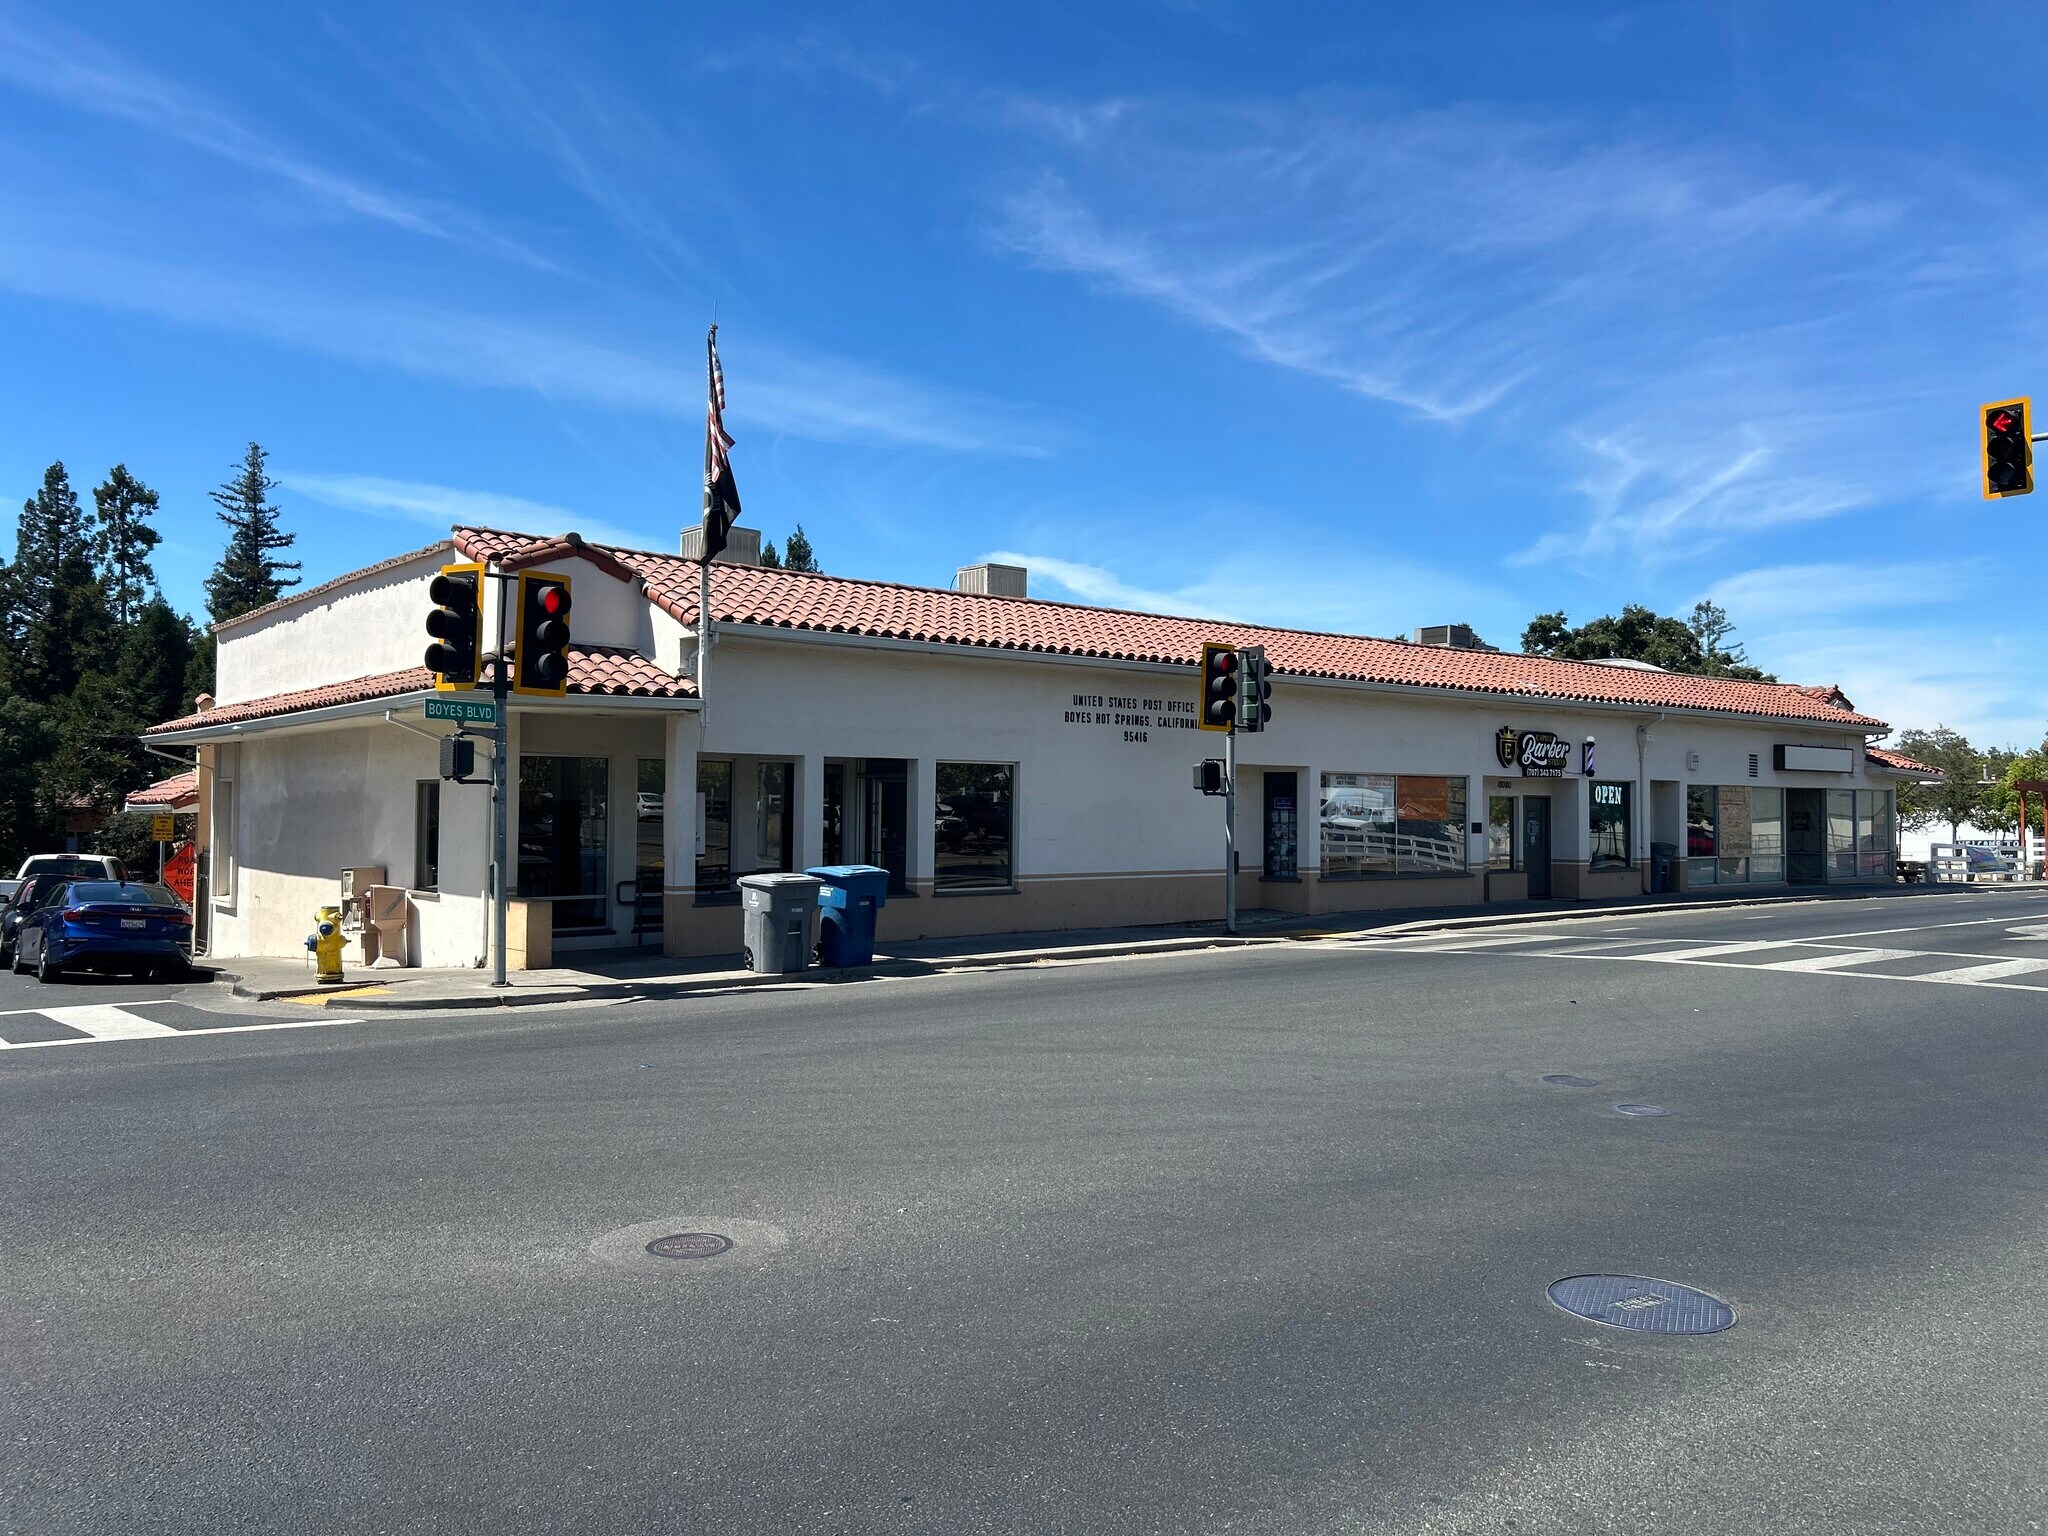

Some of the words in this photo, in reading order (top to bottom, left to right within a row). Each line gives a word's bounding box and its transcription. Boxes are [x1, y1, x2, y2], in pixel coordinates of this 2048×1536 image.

[1072, 694, 1103, 707] UNITED
[1108, 697, 1137, 709] STATES
[1142, 699, 1163, 711] POST
[1168, 701, 1195, 713] OFFICE
[428, 703, 462, 717] BOYES
[467, 706, 492, 719] BLVD
[1064, 711, 1091, 724] BOYES
[1096, 713, 1110, 724] HOT
[1124, 731, 1148, 742] 95416
[1504, 743, 1512, 758] E
[1522, 734, 1569, 765] Barber
[1527, 768, 1539, 777] (707)
[1540, 769, 1549, 777] 343
[1549, 769, 1561, 777] 7175
[1595, 785, 1622, 805] OPEN
[178, 856, 195, 864] ROA
[174, 879, 194, 887] AHE
